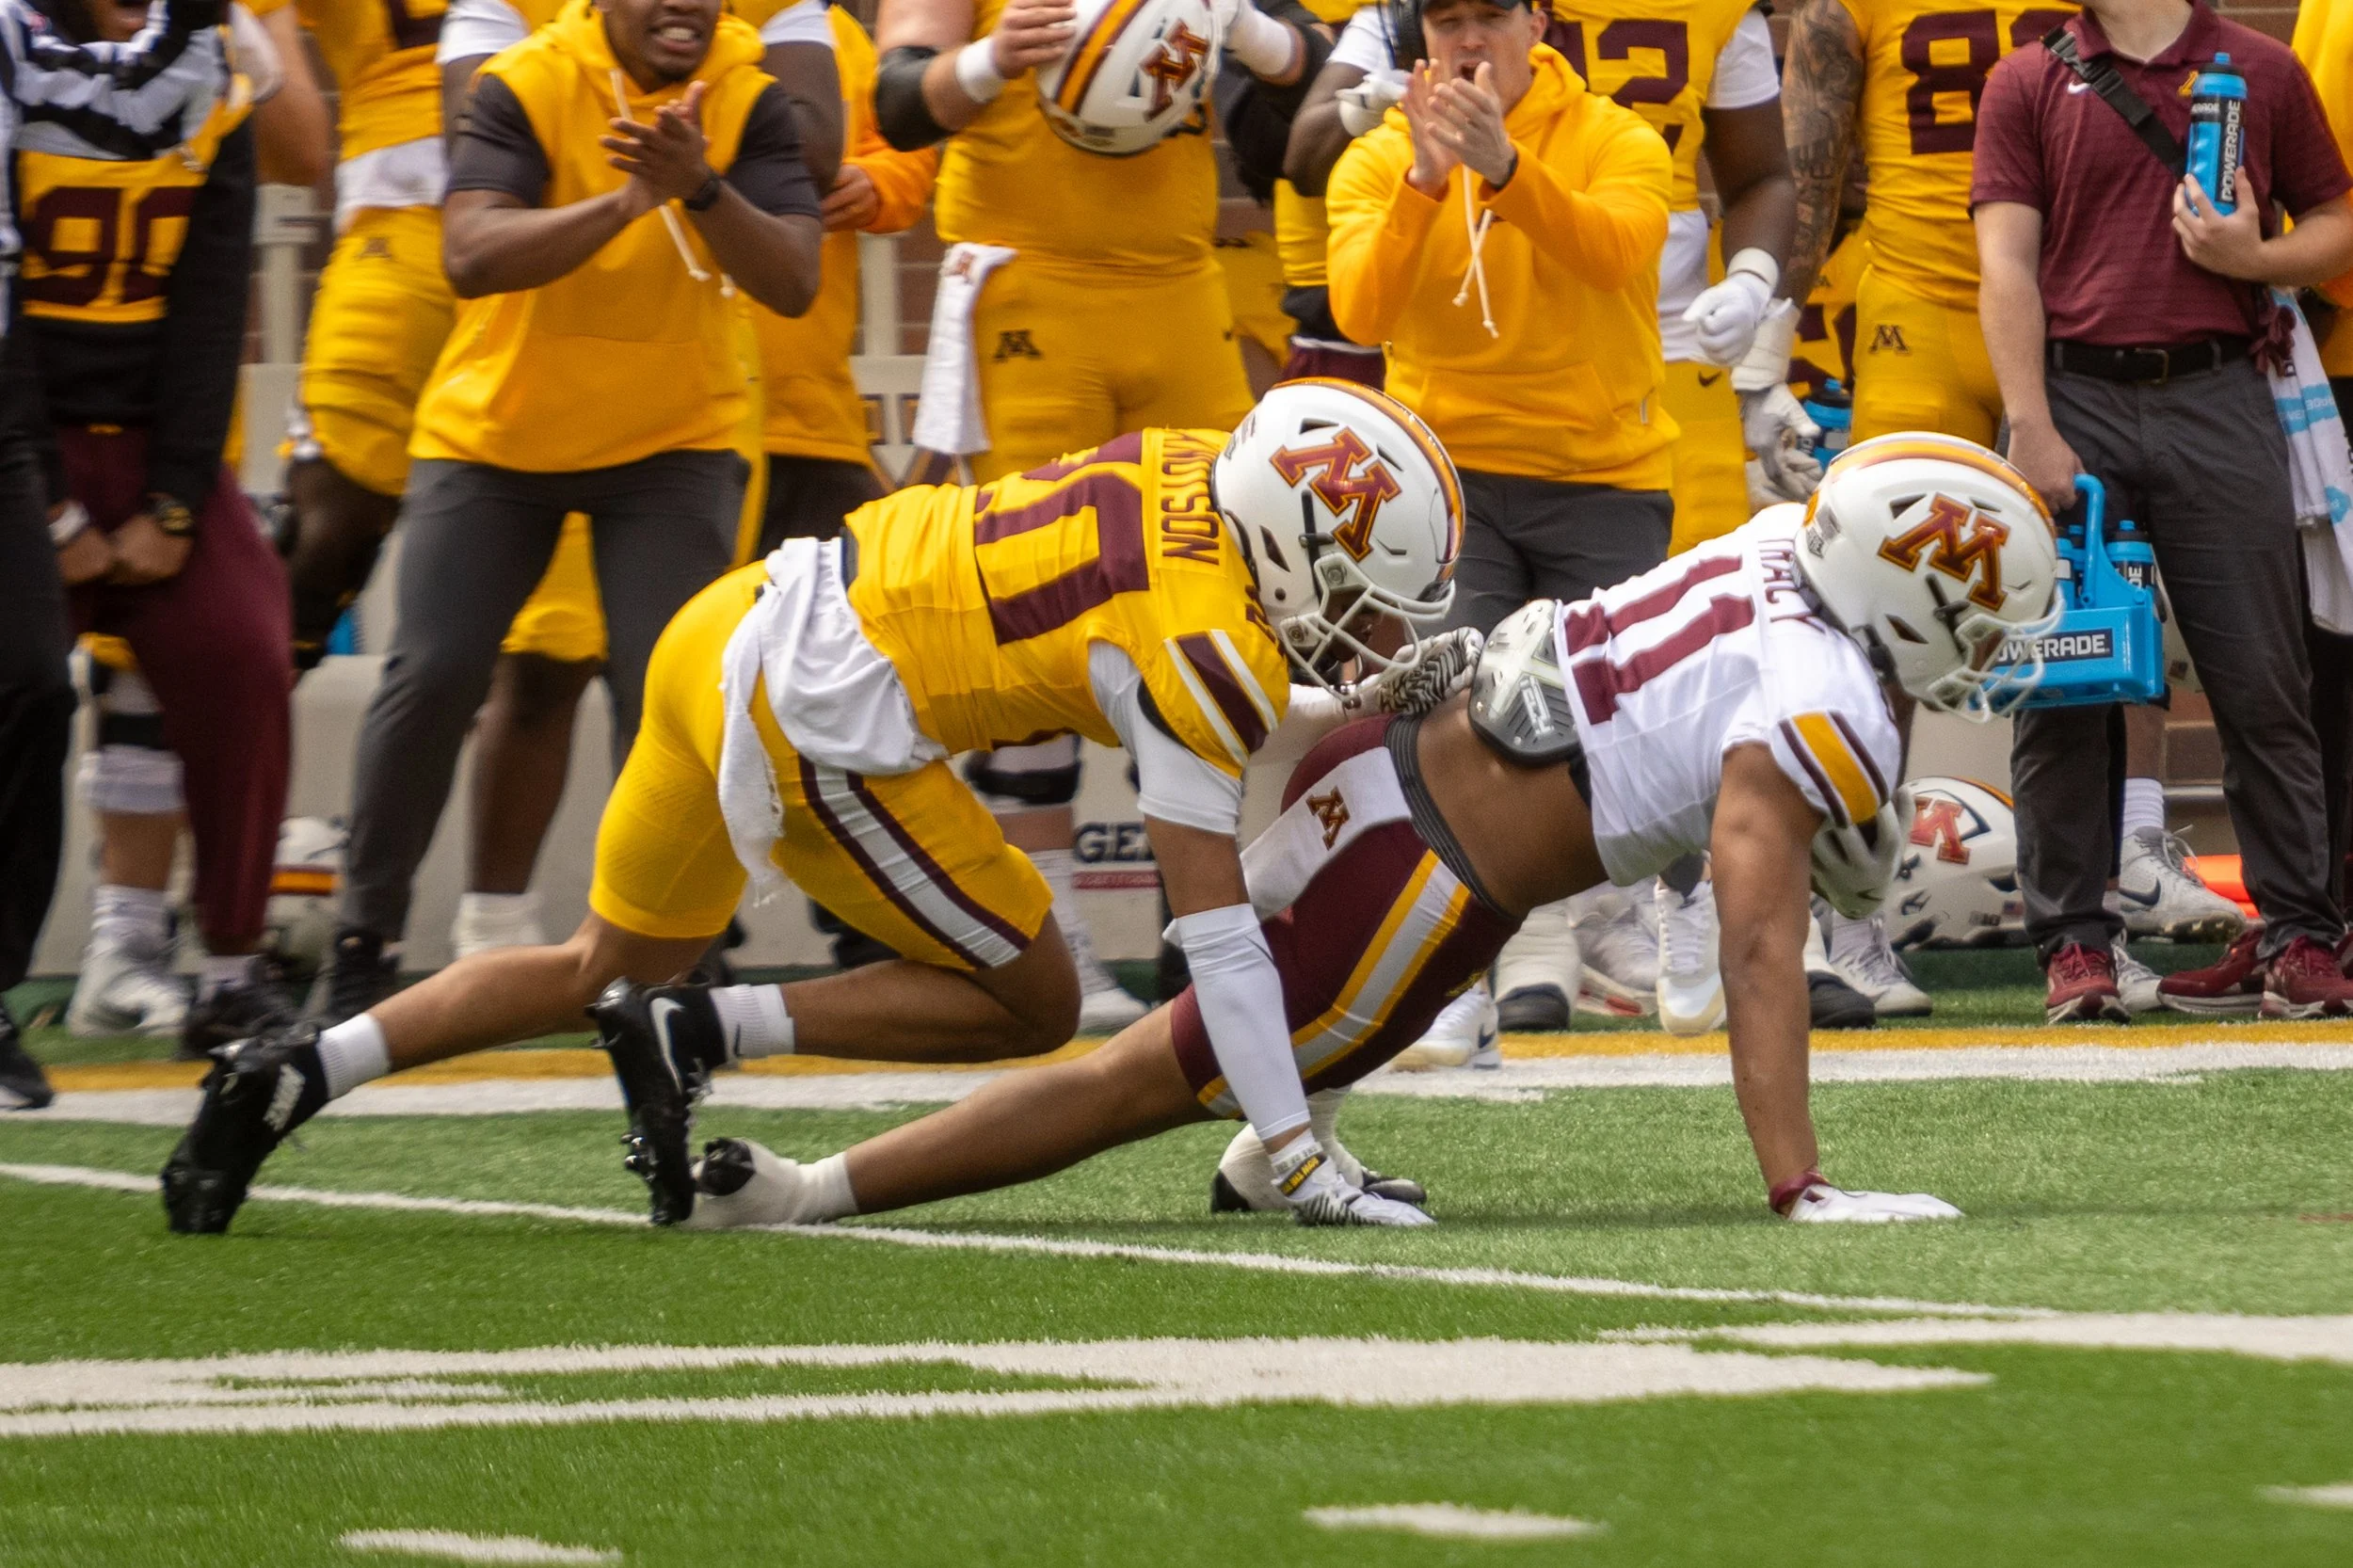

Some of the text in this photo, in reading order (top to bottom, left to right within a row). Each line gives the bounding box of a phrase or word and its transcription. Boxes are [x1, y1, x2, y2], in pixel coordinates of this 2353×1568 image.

[2220, 99, 2241, 202] POWERADE
[1269, 426, 1402, 563] M
[1877, 491, 2010, 612] M
[1564, 553, 1756, 726] 11
